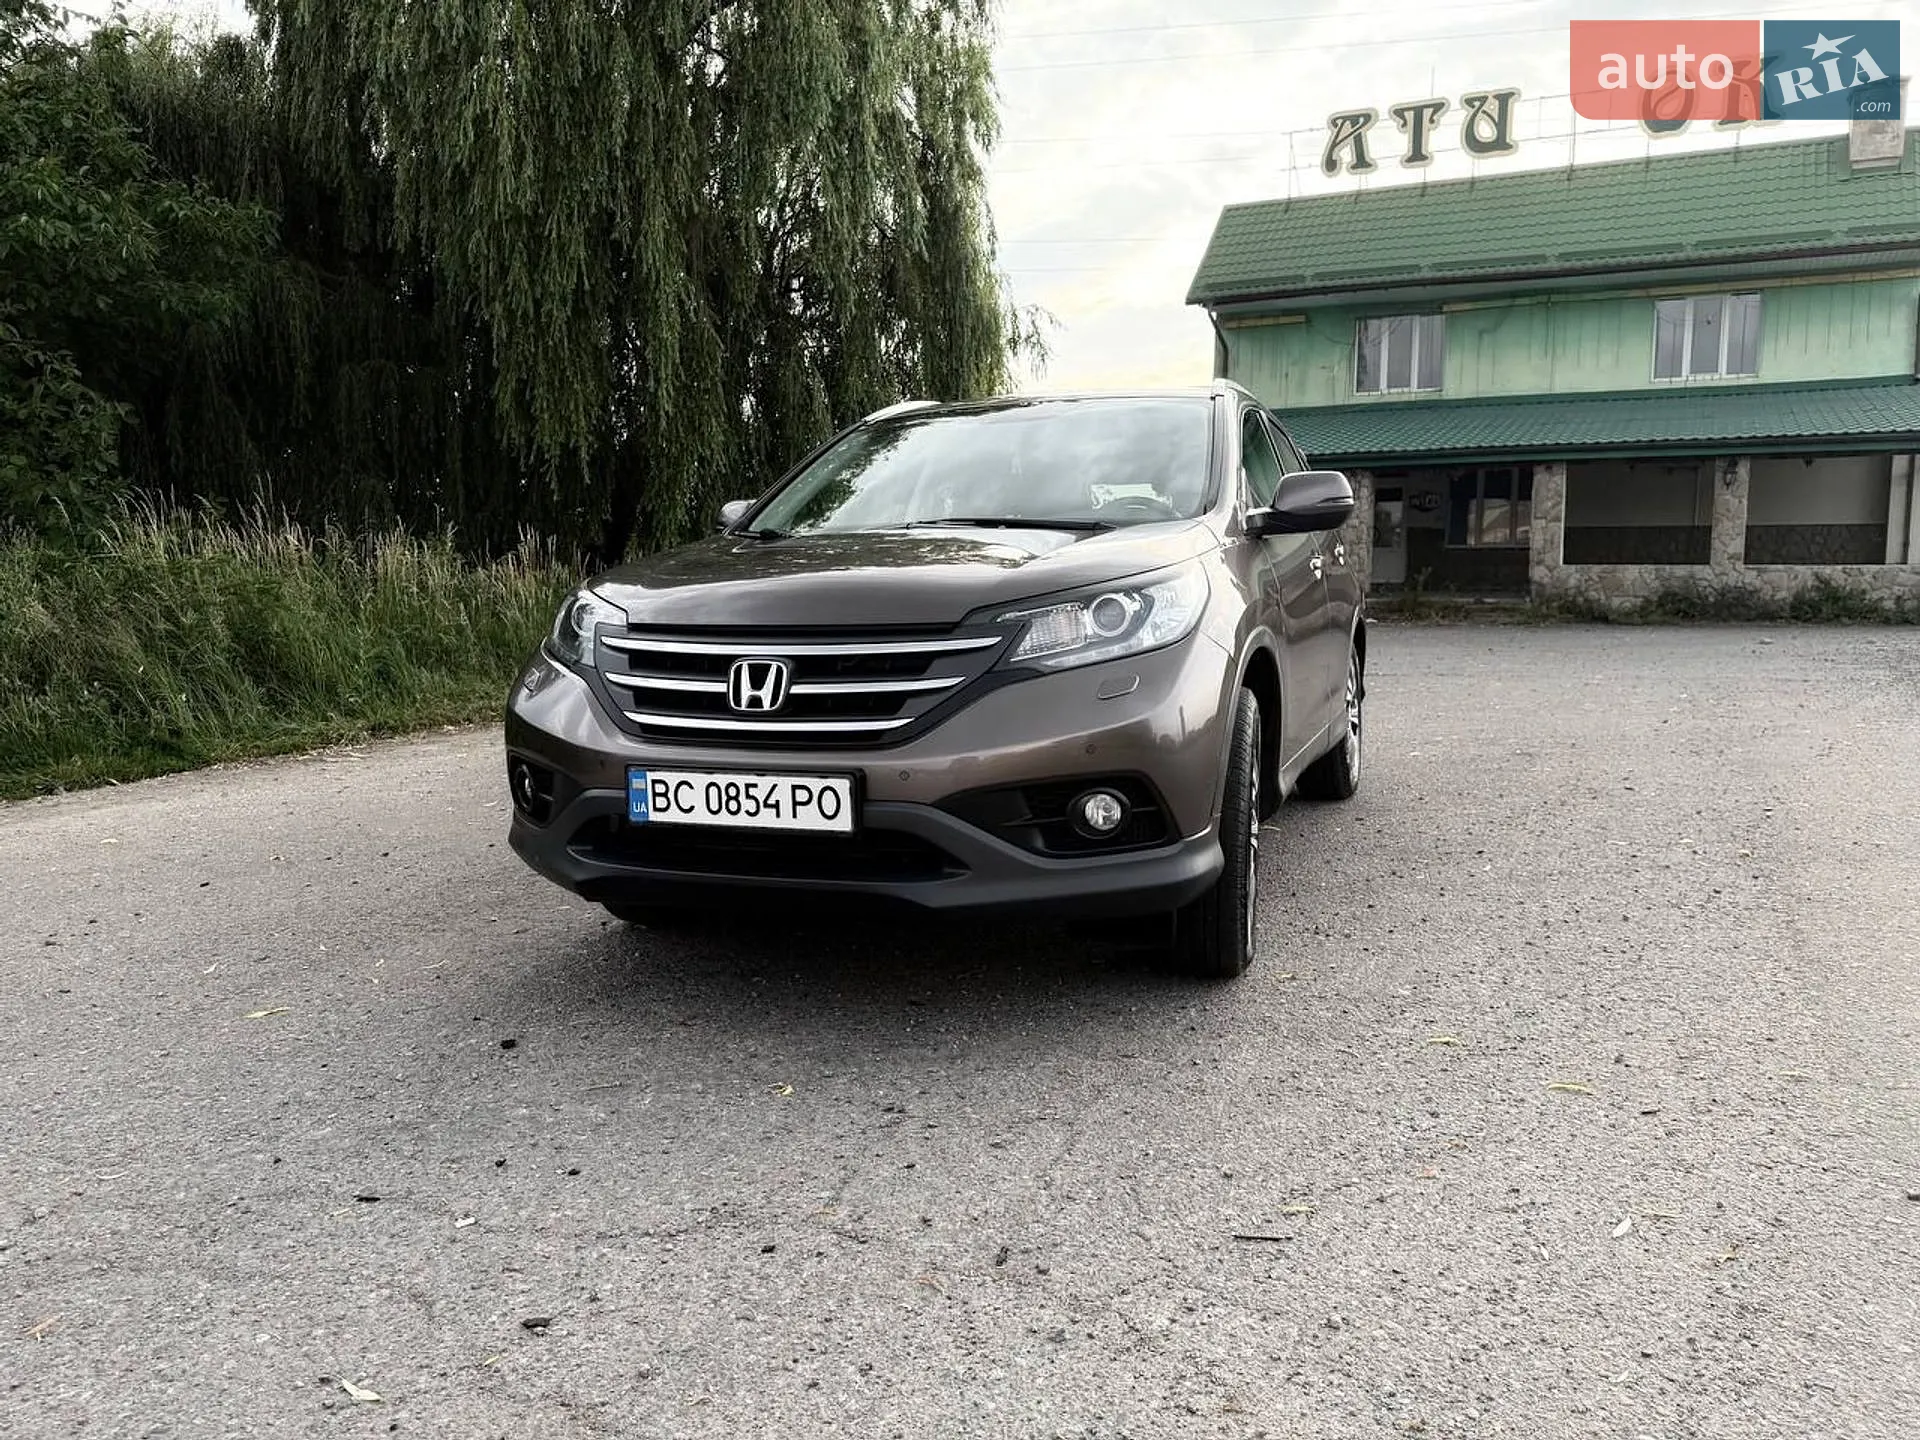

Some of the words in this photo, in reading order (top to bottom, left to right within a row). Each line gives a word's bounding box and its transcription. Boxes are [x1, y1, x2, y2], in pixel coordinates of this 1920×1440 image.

[633, 803, 647, 813] UA
[651, 779, 695, 814] BC
[705, 781, 780, 818] 0854
[791, 784, 841, 820] PO
